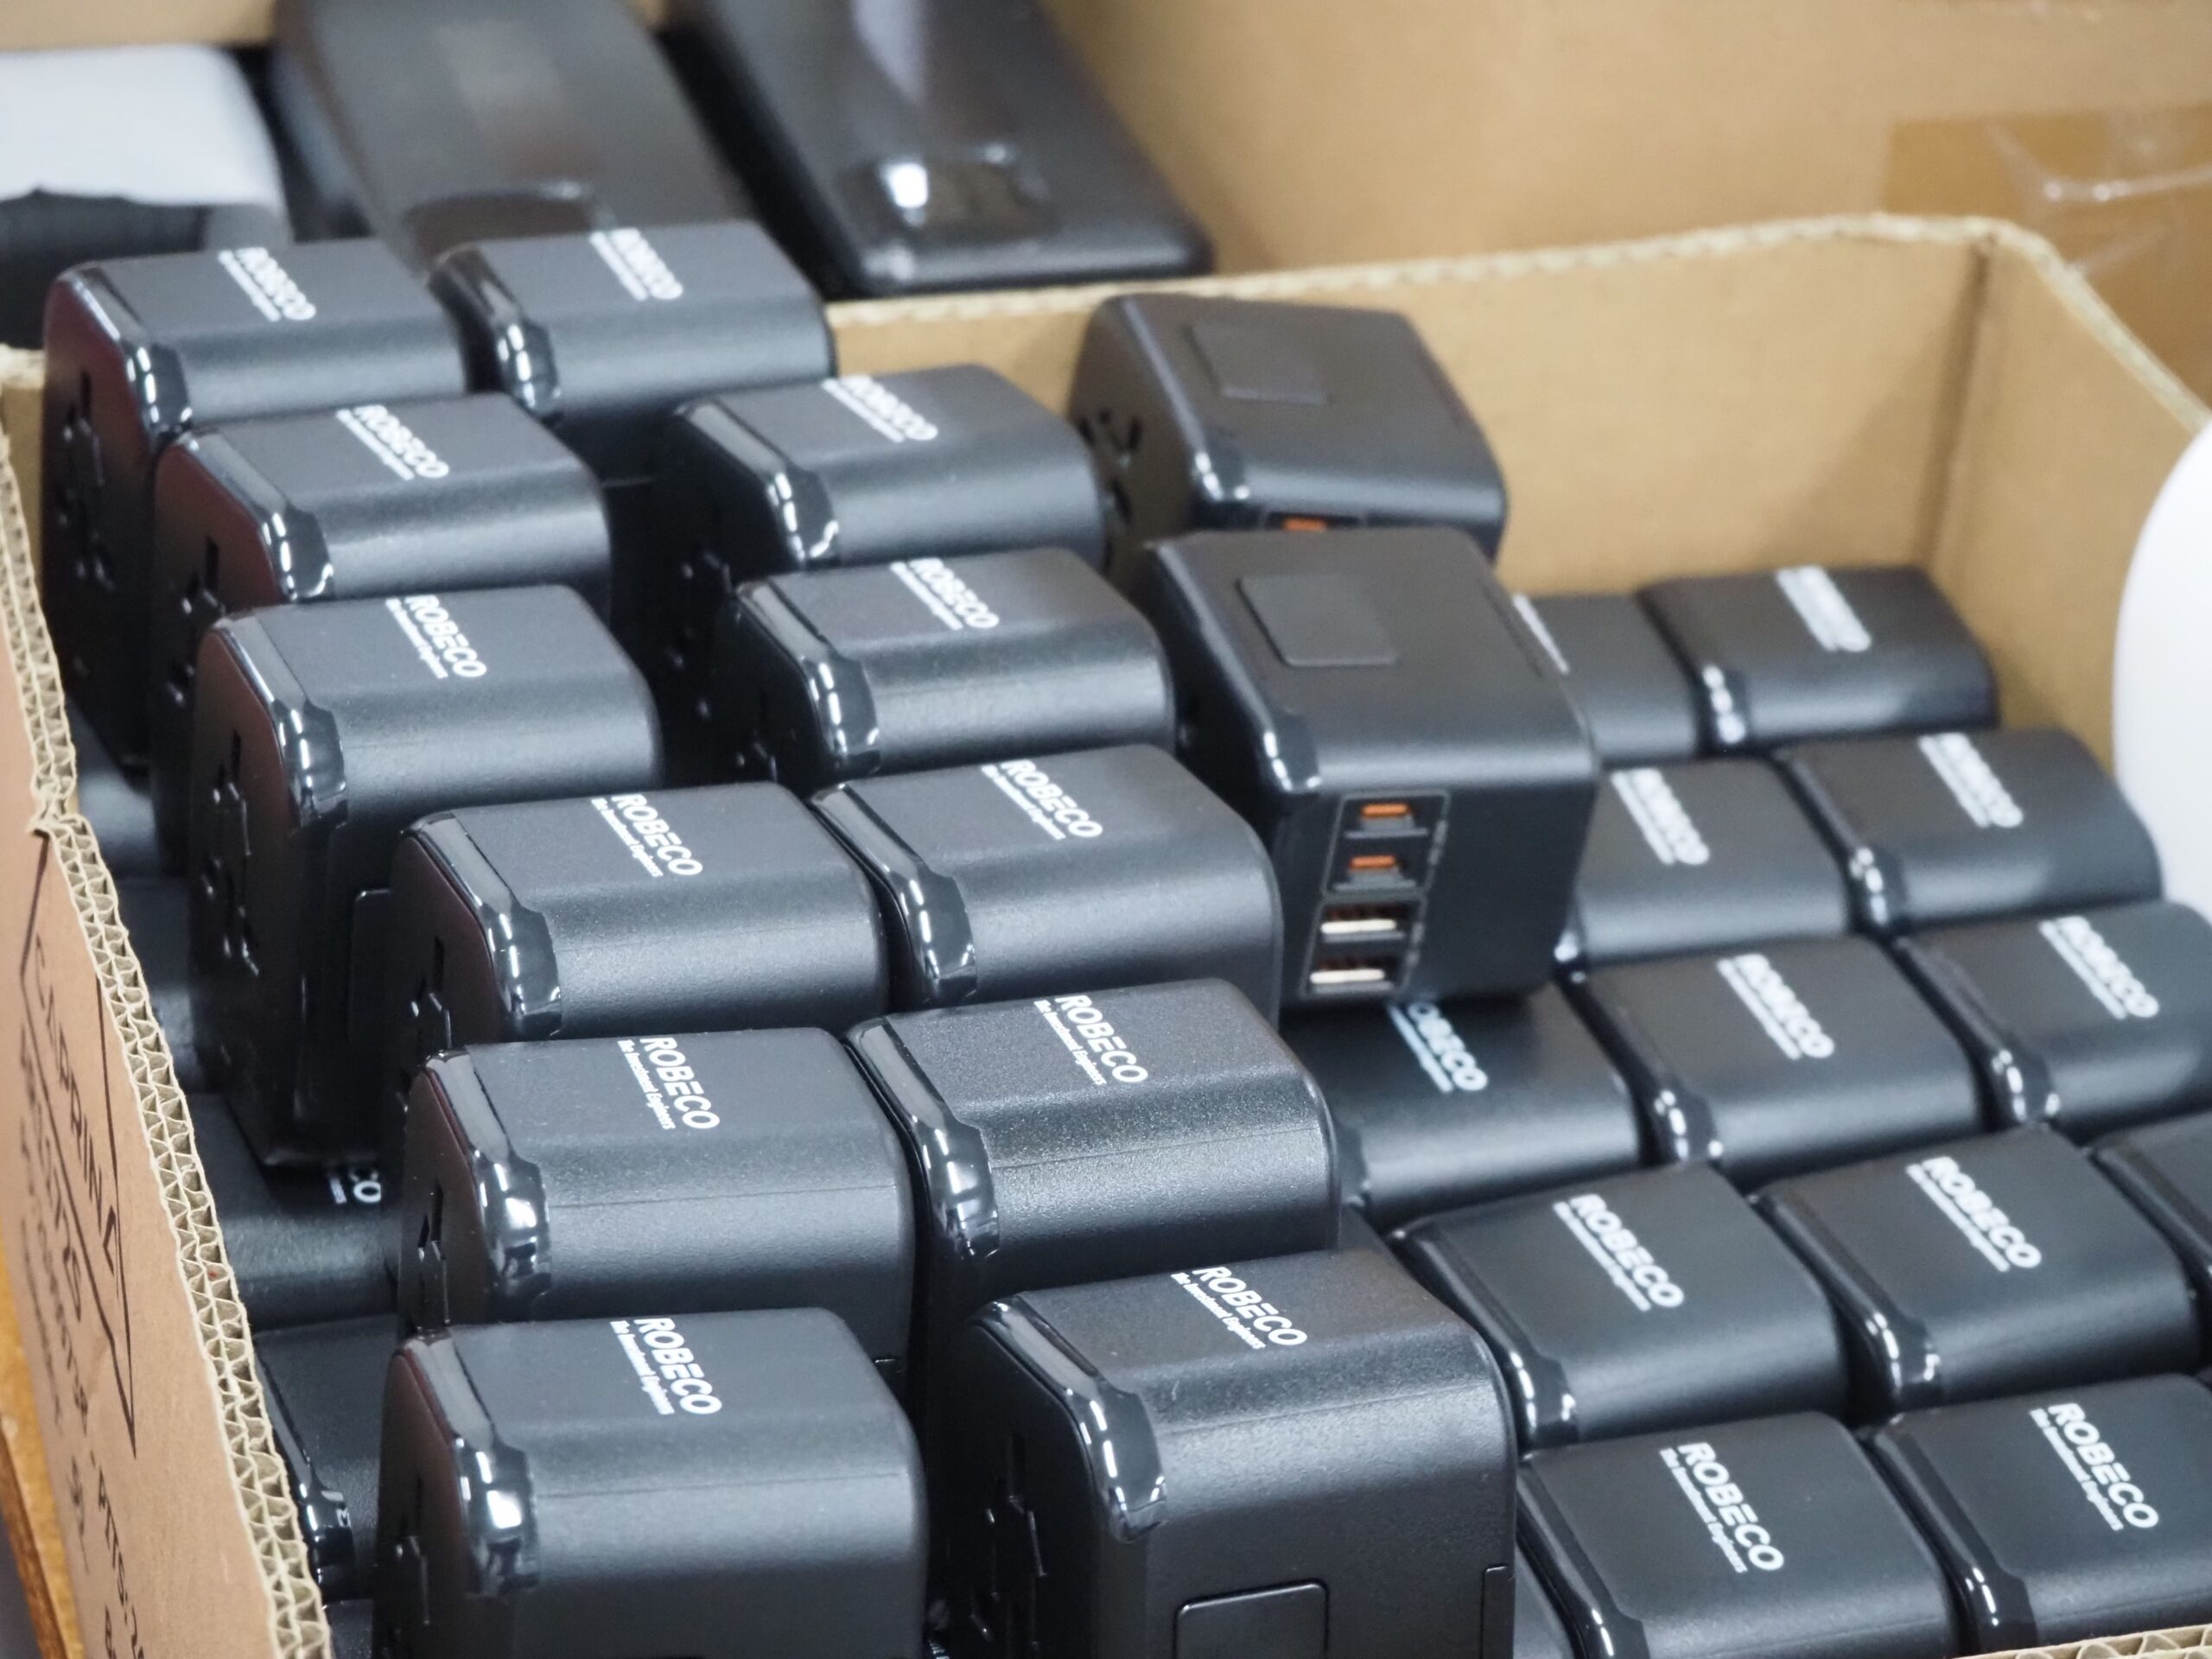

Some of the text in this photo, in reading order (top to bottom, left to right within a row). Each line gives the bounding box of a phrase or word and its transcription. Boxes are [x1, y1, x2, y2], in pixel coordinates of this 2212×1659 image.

[404, 594, 487, 677] ROBECO
[909, 557, 999, 629] ROBECO
[611, 794, 702, 875] ROBECO
[1001, 759, 1103, 837] ROBECO
[639, 1038, 720, 1128] ROBECO
[1055, 995, 1148, 1083] ROBECO
[1408, 1001, 1488, 1091] OBECO
[1569, 1193, 1685, 1307] ROBECO
[1922, 1156, 2042, 1268] ROBECO
[1192, 1267, 1307, 1345] ROBECO
[633, 1318, 722, 1414] ROBECO
[1677, 1442, 1784, 1570] ROBECO
[2047, 1402, 2159, 1529] ROBECO
